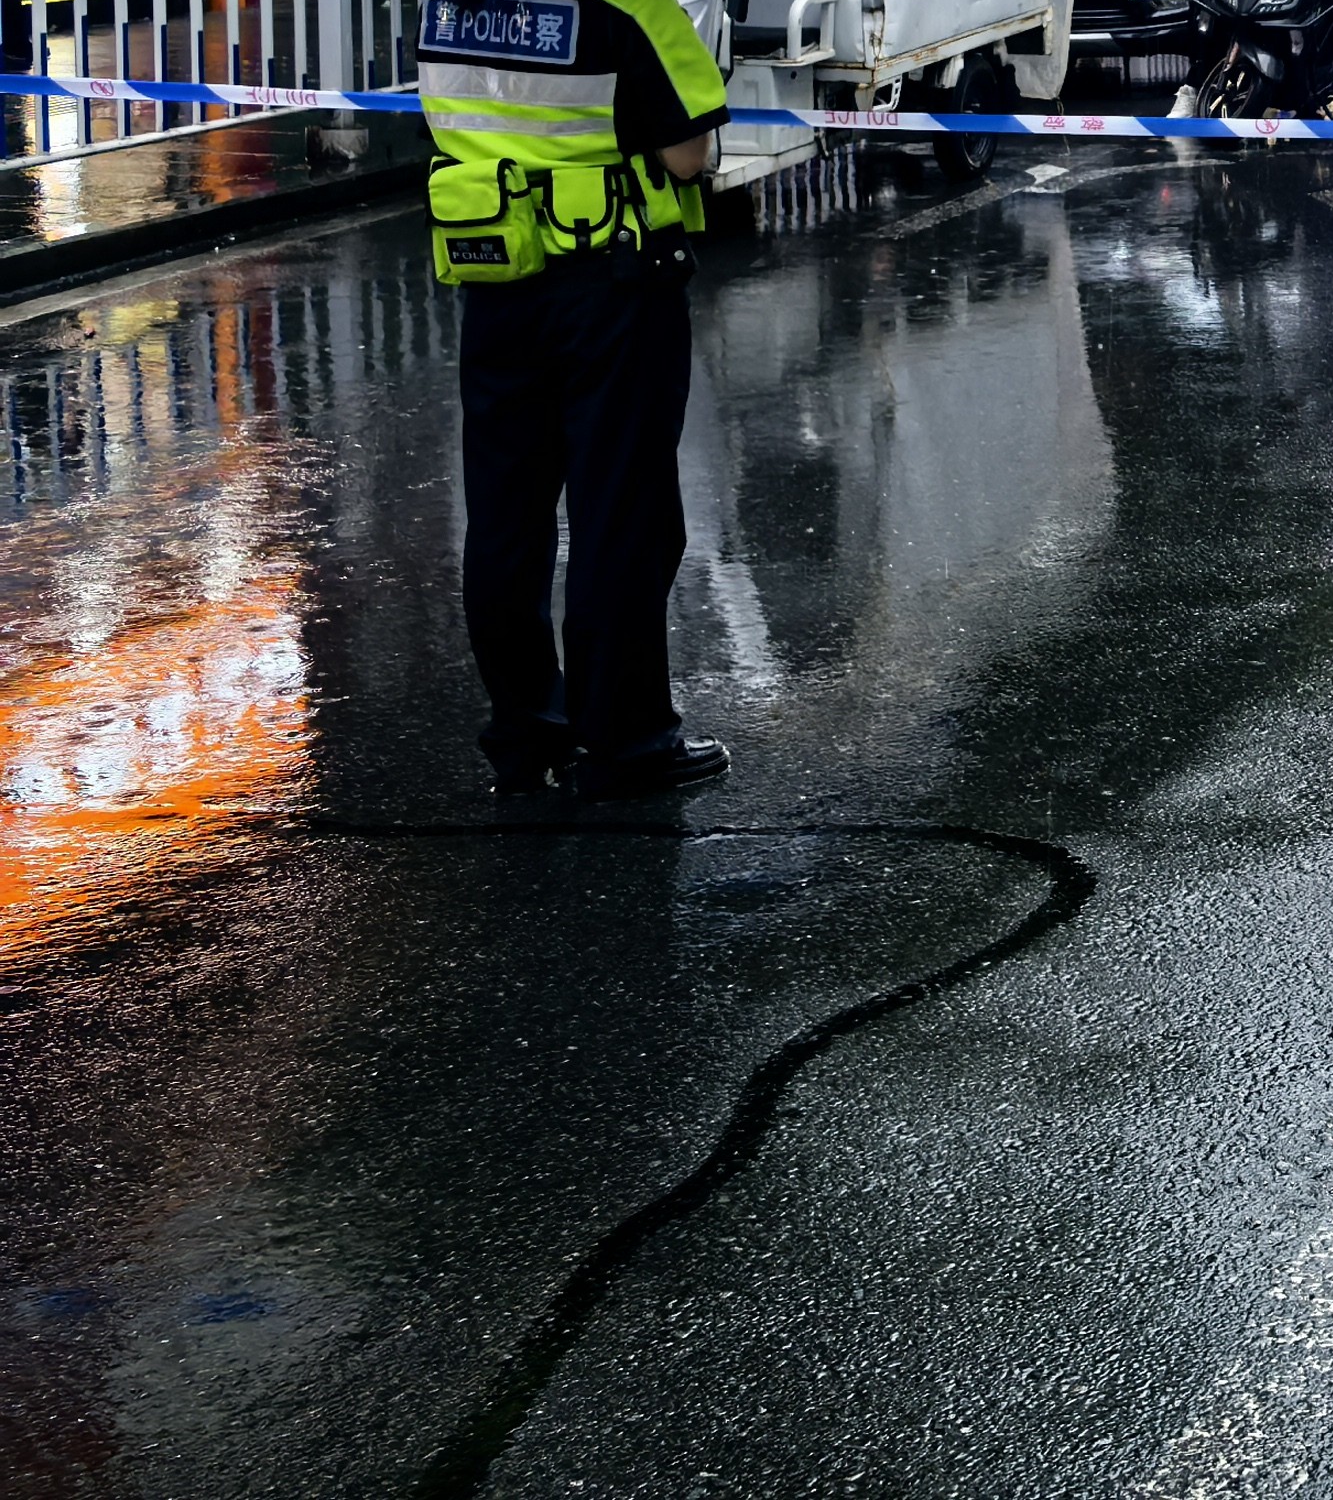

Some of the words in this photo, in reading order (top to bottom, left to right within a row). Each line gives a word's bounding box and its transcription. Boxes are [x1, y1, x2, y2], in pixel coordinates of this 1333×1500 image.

[435, 0, 460, 43] 警
[460, 6, 532, 48] POLICE
[535, 12, 564, 52] 察
